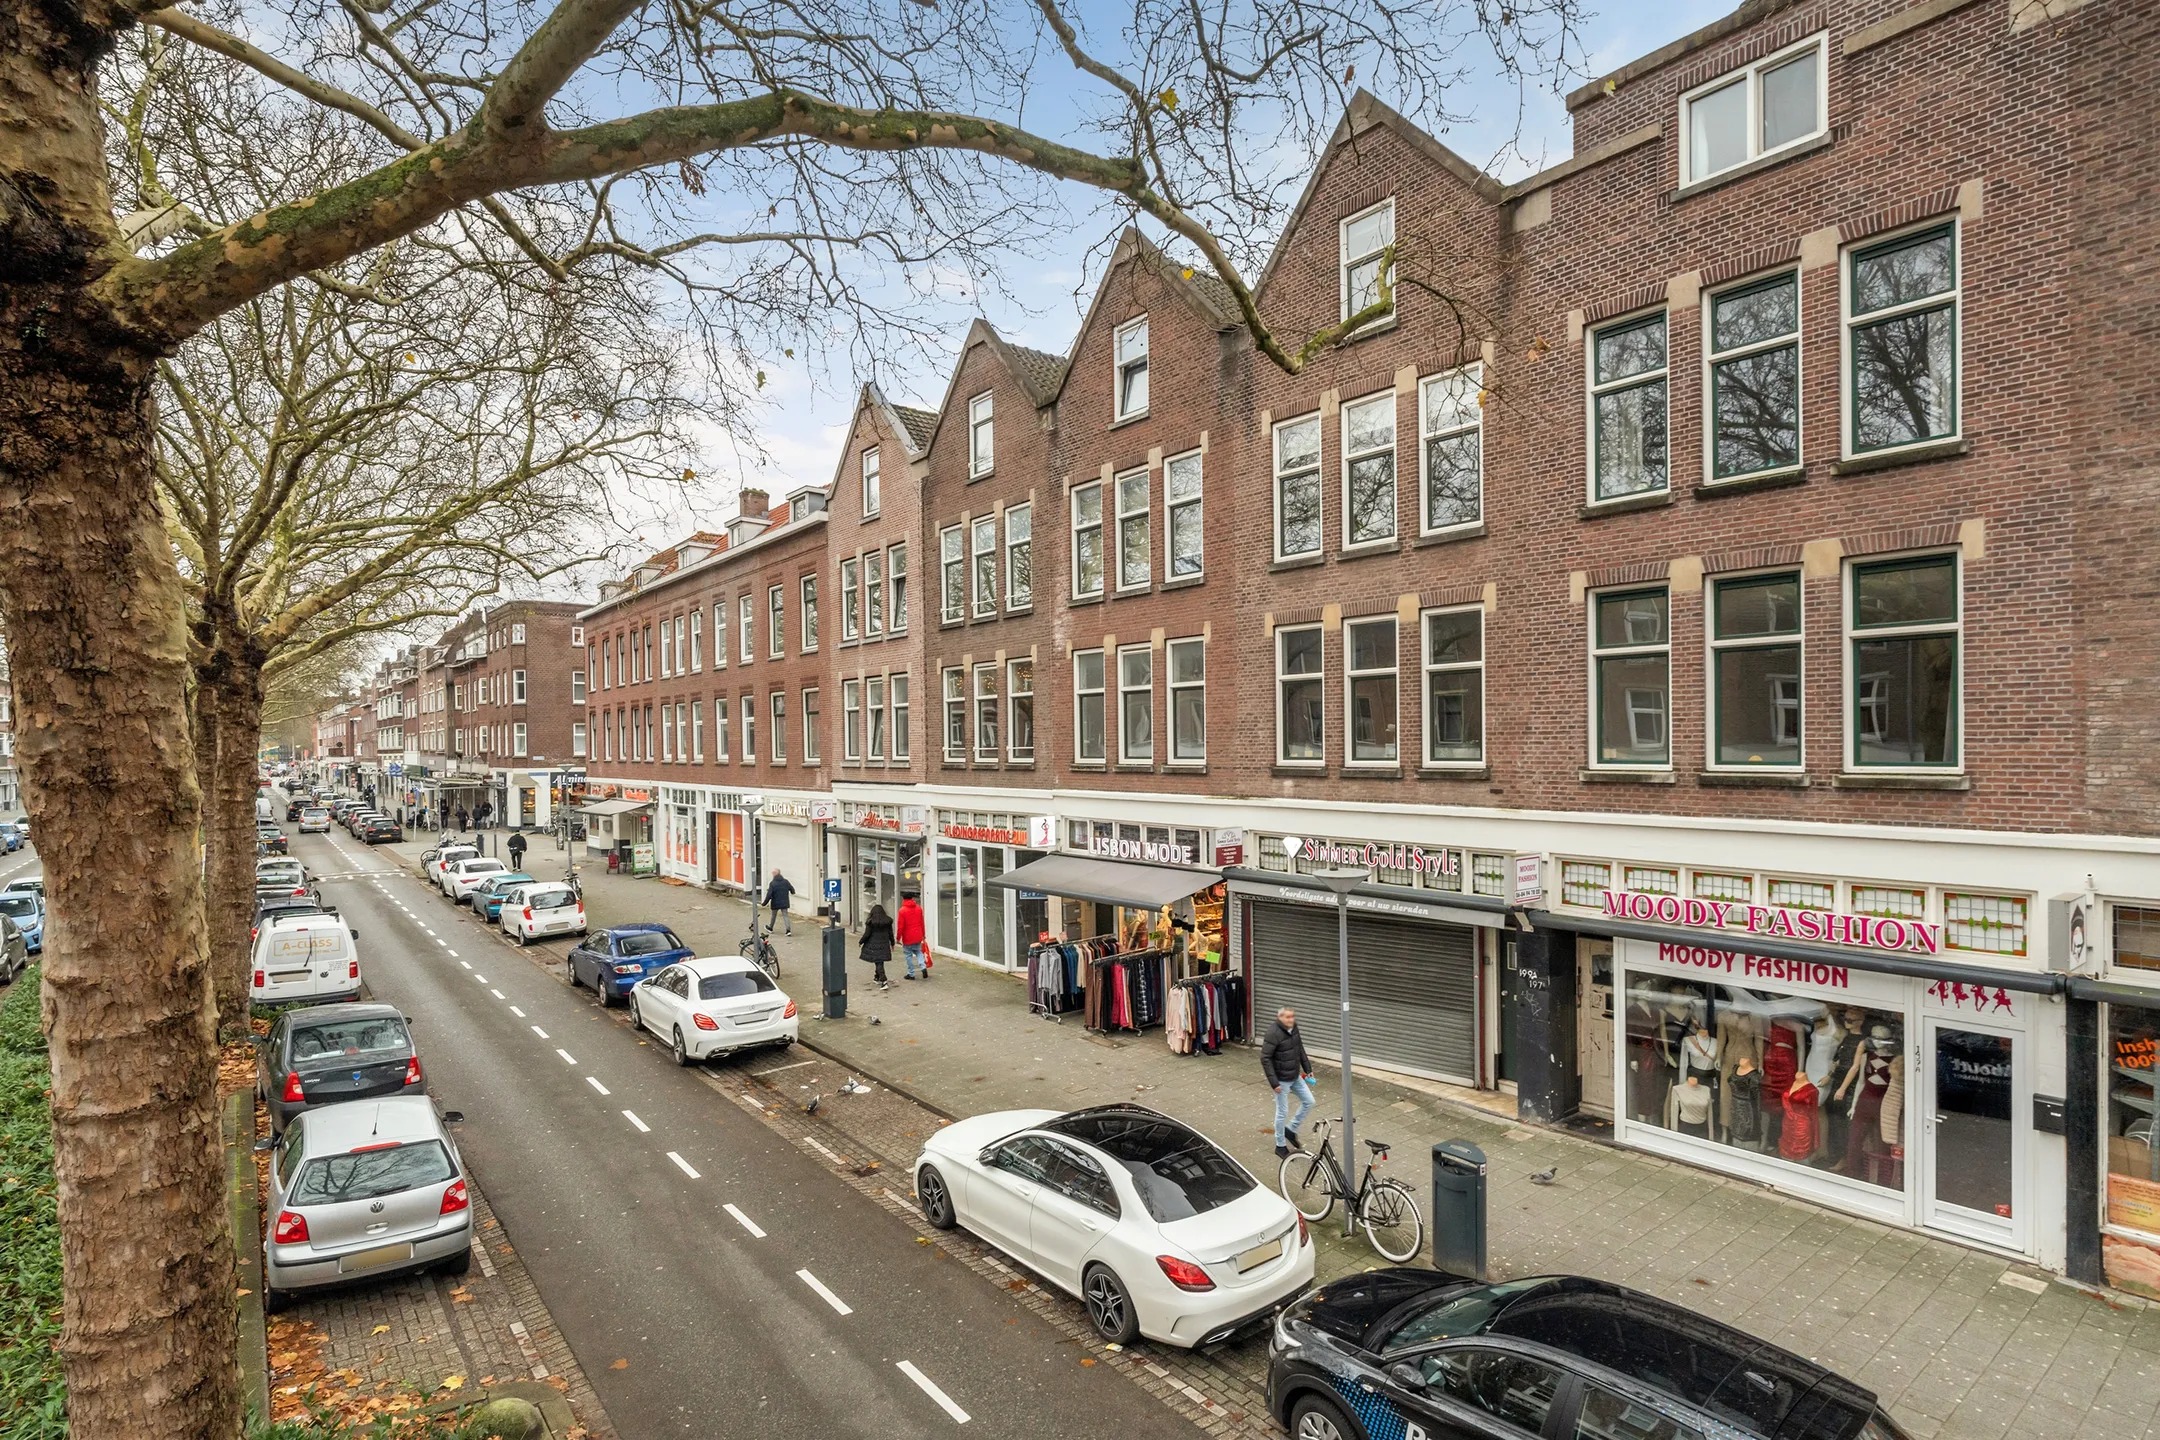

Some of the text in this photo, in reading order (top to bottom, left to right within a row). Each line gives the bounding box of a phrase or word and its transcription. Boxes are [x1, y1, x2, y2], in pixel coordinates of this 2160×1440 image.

[1089, 837, 1192, 865] LISBON MODE
[1363, 842, 1407, 870] Gold
[829, 880, 838, 891] P
[1367, 899, 1376, 908] al
[1392, 903, 1429, 916] sieraden
[1602, 890, 1942, 954] MOODY FASHION
[283, 939, 333, 951] A-CLASS
[1658, 942, 1849, 989] MOODY FASHION
[2116, 1038, 2157, 1054] Insh
